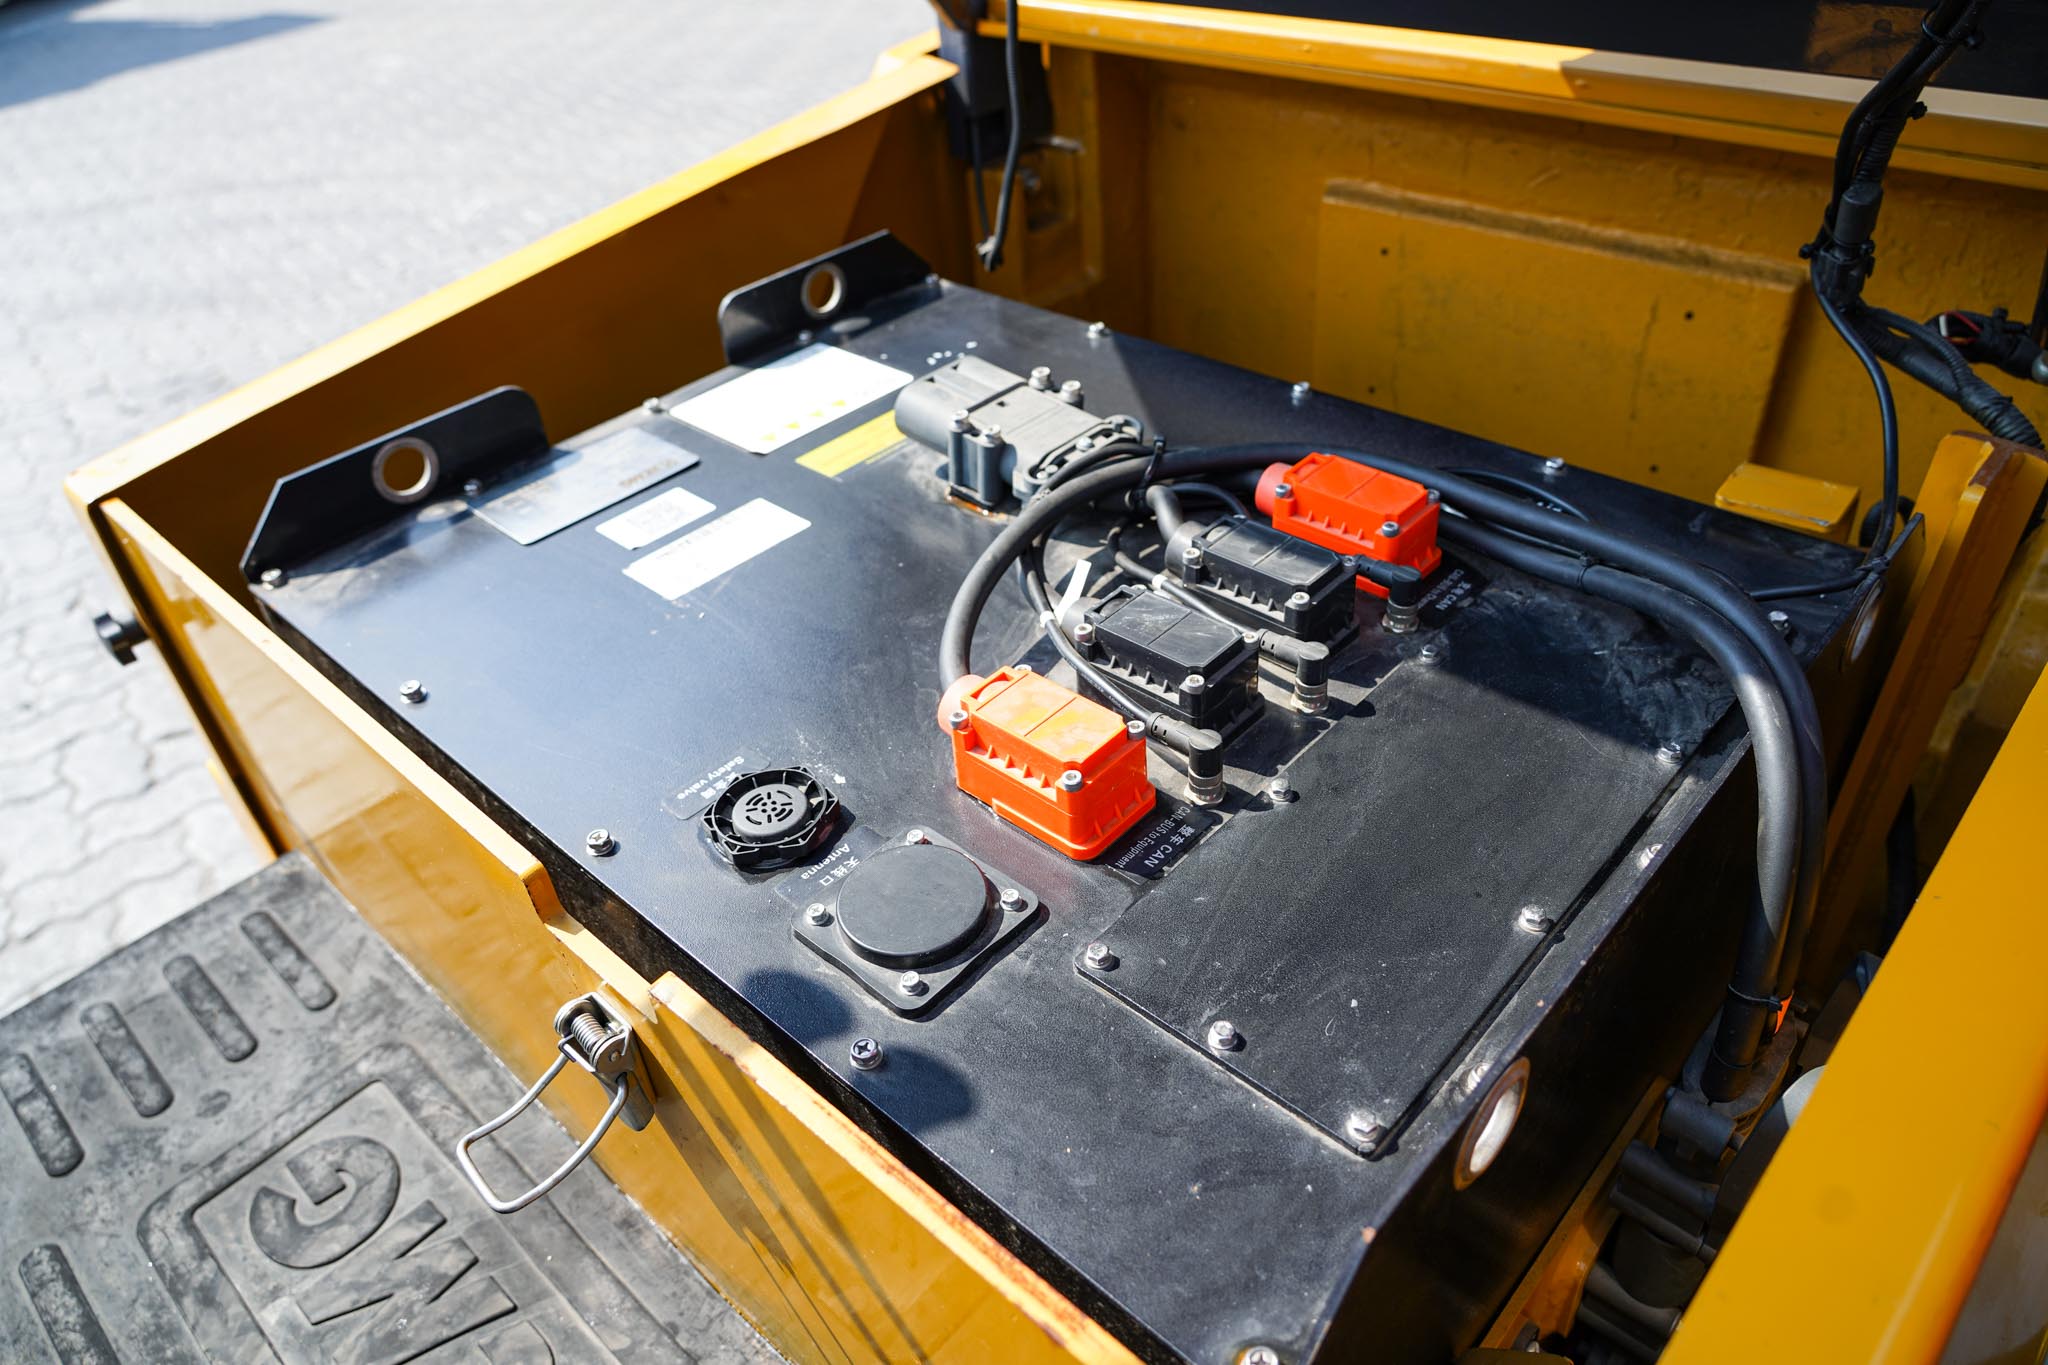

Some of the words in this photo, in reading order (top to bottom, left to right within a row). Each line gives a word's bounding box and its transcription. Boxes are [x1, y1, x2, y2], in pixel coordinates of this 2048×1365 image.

[707, 756, 745, 780] Safety
[676, 779, 708, 800] valve
[1156, 806, 1191, 834] CAN-BUS
[1148, 831, 1161, 839] to
[1170, 824, 1196, 846] 整车
[800, 843, 850, 880] Antenna
[1115, 837, 1155, 869] Equipment
[1144, 844, 1173, 868] CAN
[819, 855, 860, 887] 天线口
[249, 1135, 556, 1365] MG
